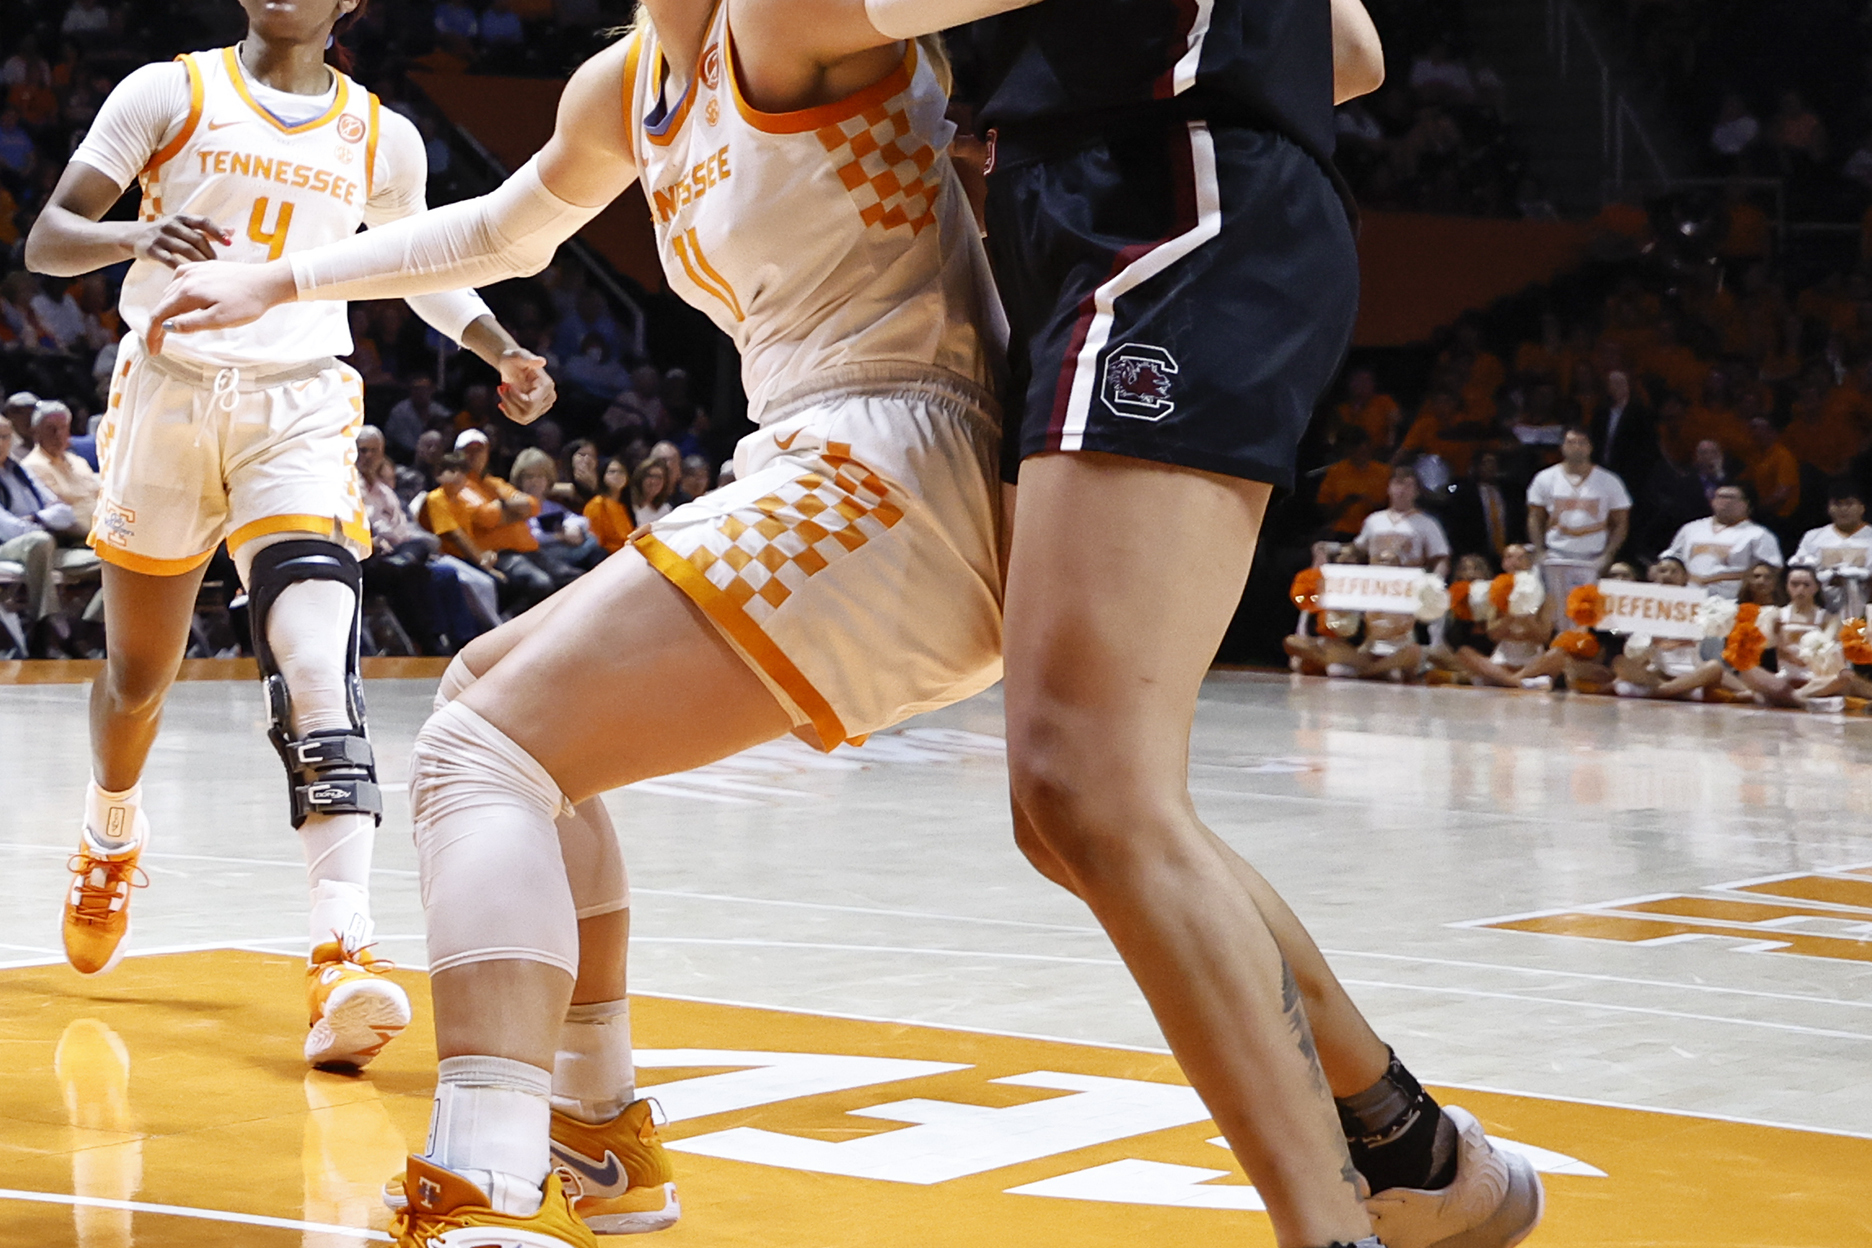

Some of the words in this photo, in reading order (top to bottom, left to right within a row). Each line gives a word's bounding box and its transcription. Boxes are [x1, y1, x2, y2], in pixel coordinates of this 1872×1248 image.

[196, 150, 358, 206] TENNESSEE
[246, 196, 296, 263] 4
[669, 226, 746, 323] 11
